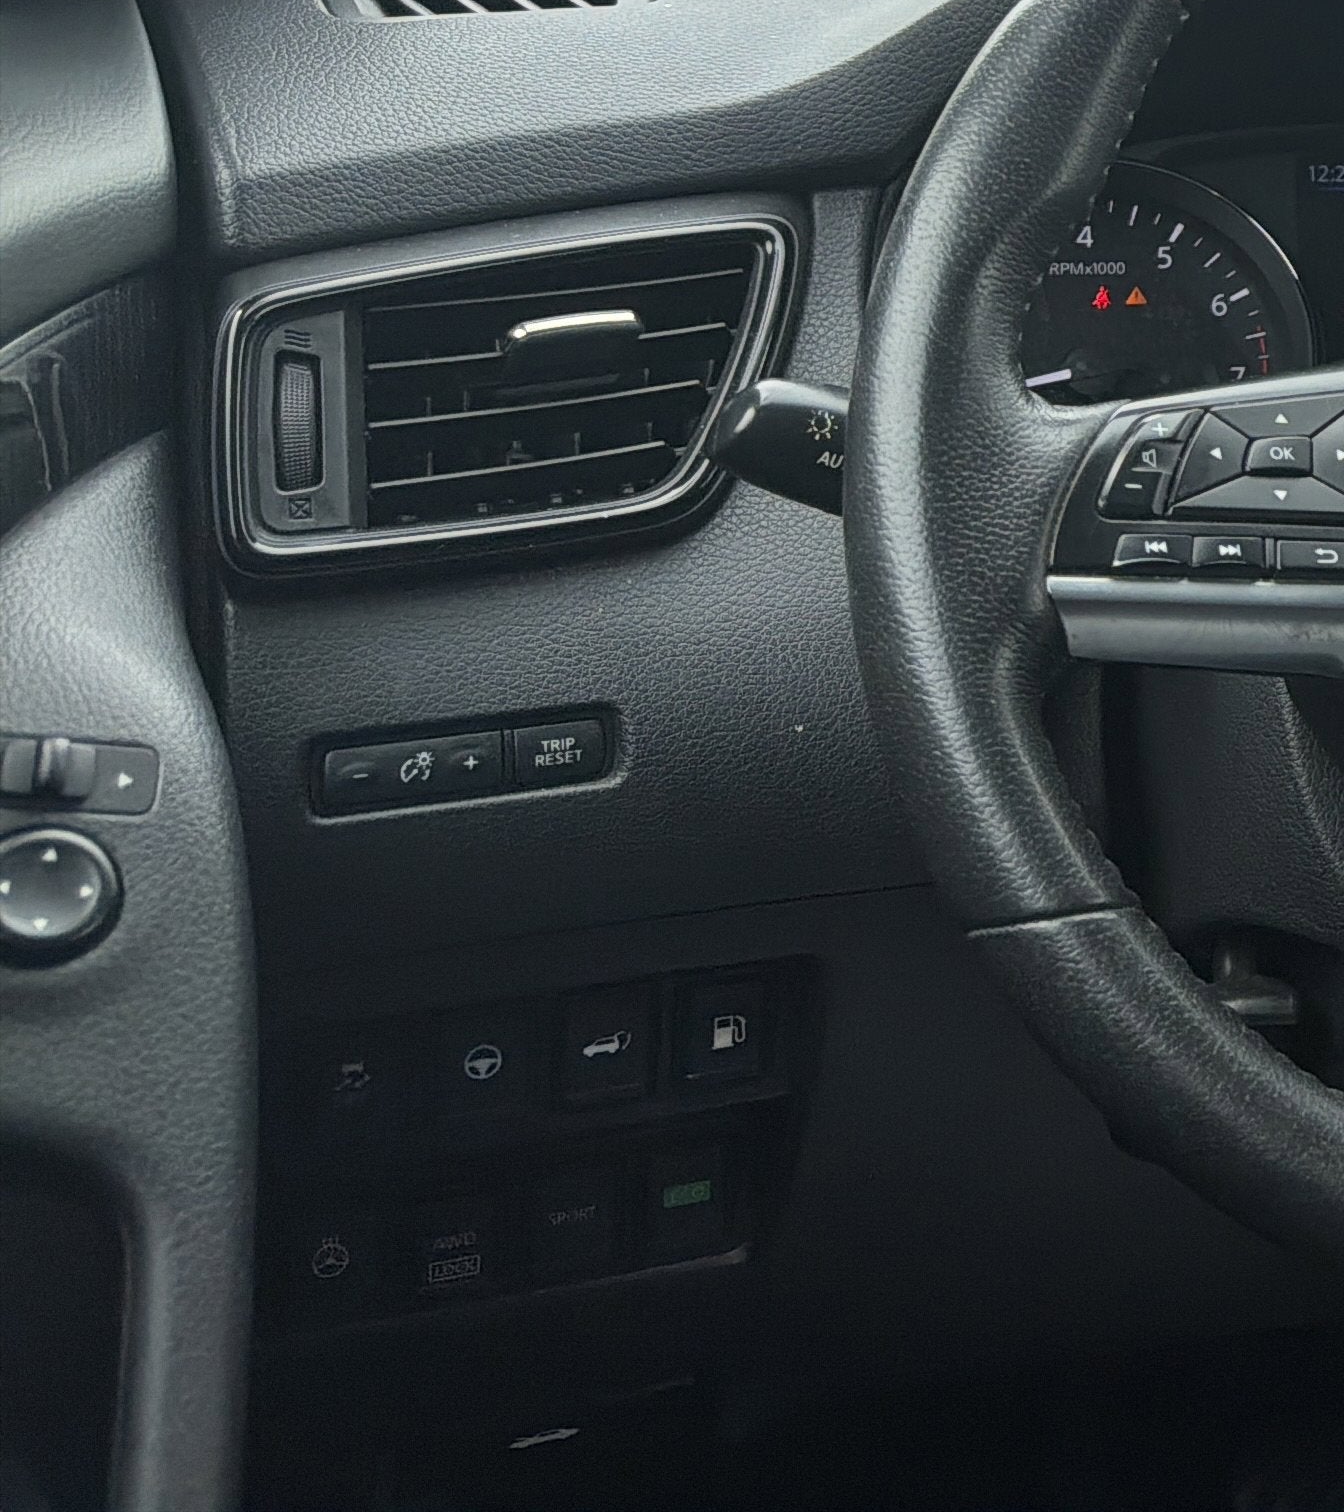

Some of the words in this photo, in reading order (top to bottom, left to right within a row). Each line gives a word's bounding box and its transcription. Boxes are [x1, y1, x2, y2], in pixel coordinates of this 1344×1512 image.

[1075, 225, 1094, 249] 4
[1156, 246, 1173, 269] 5
[1048, 261, 1126, 277] RPMx1000
[1211, 293, 1229, 316] 6
[816, 451, 844, 469] AU
[1269, 446, 1296, 461] OK
[541, 737, 575, 752] TRIP
[535, 749, 582, 766] RESET
